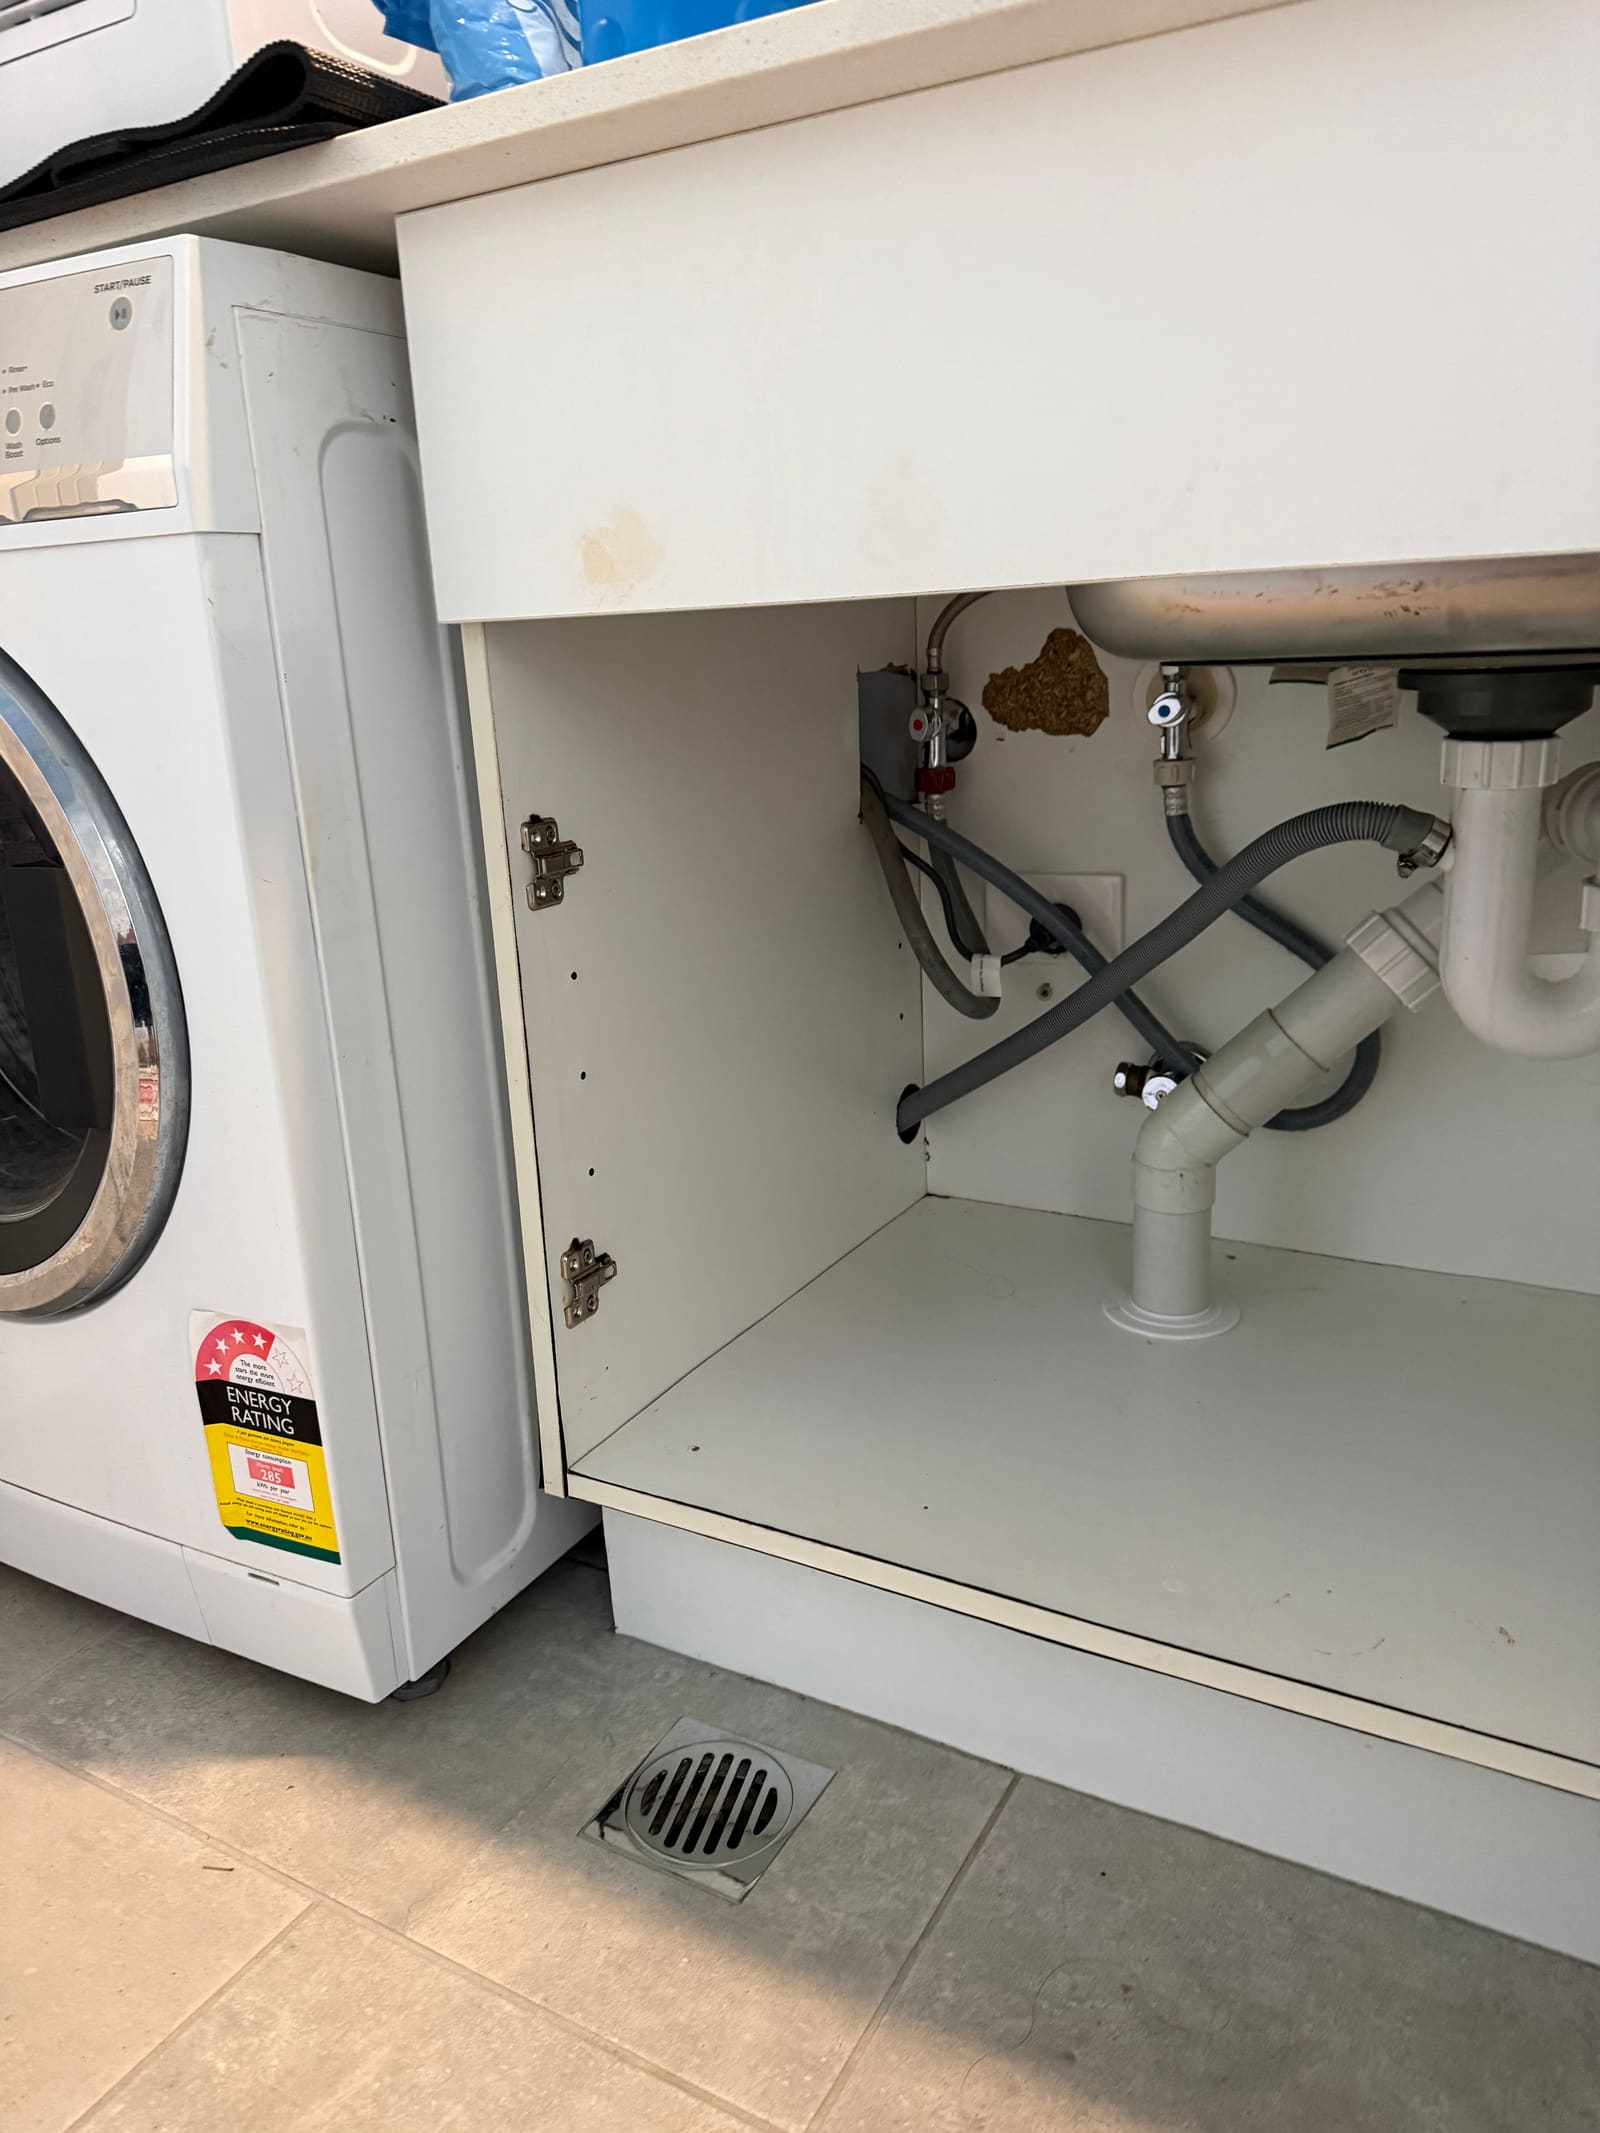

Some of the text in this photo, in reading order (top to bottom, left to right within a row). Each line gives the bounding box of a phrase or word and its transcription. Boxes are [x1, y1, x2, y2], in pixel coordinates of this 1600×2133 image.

[94, 275, 152, 294] START/PAUSE
[35, 437, 61, 446] Options
[240, 1359, 251, 1368] The
[226, 1386, 292, 1416] ENERGY
[231, 1406, 295, 1435] RATING
[260, 1468, 282, 1484] 285
